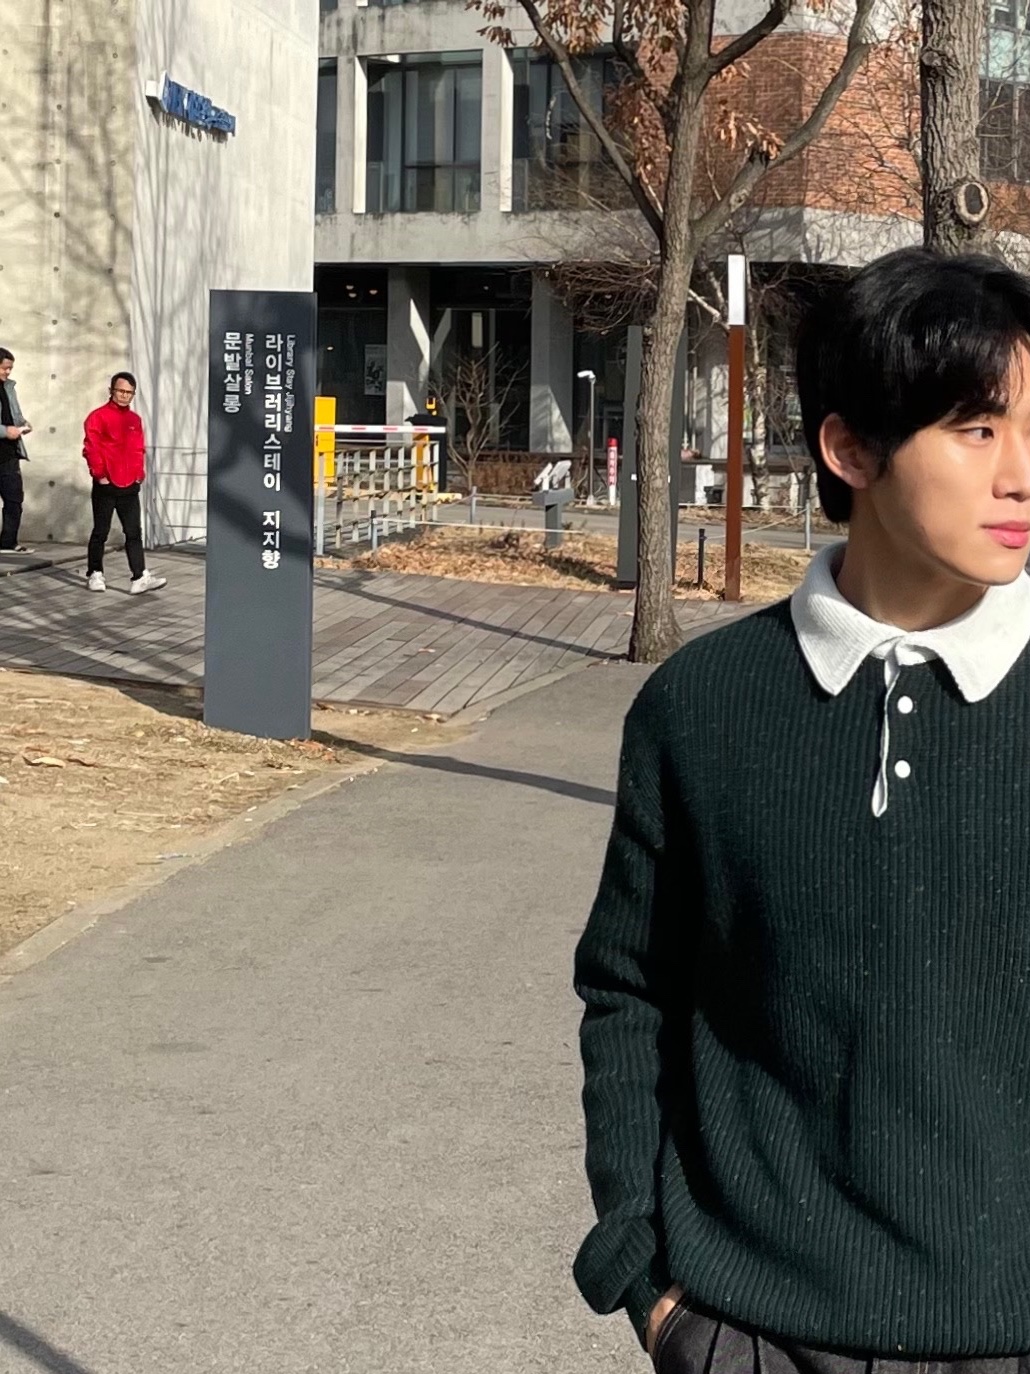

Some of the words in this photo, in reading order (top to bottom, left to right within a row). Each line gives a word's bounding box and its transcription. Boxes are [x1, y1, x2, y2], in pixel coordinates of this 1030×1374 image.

[244, 333, 255, 367] Munbal
[285, 334, 296, 367] Library
[223, 332, 243, 413] 문발살롱
[244, 368, 254, 395] Salon
[285, 369, 296, 390] Stay
[262, 333, 284, 492] 라이브러리스테이
[261, 510, 281, 570] 지지향
